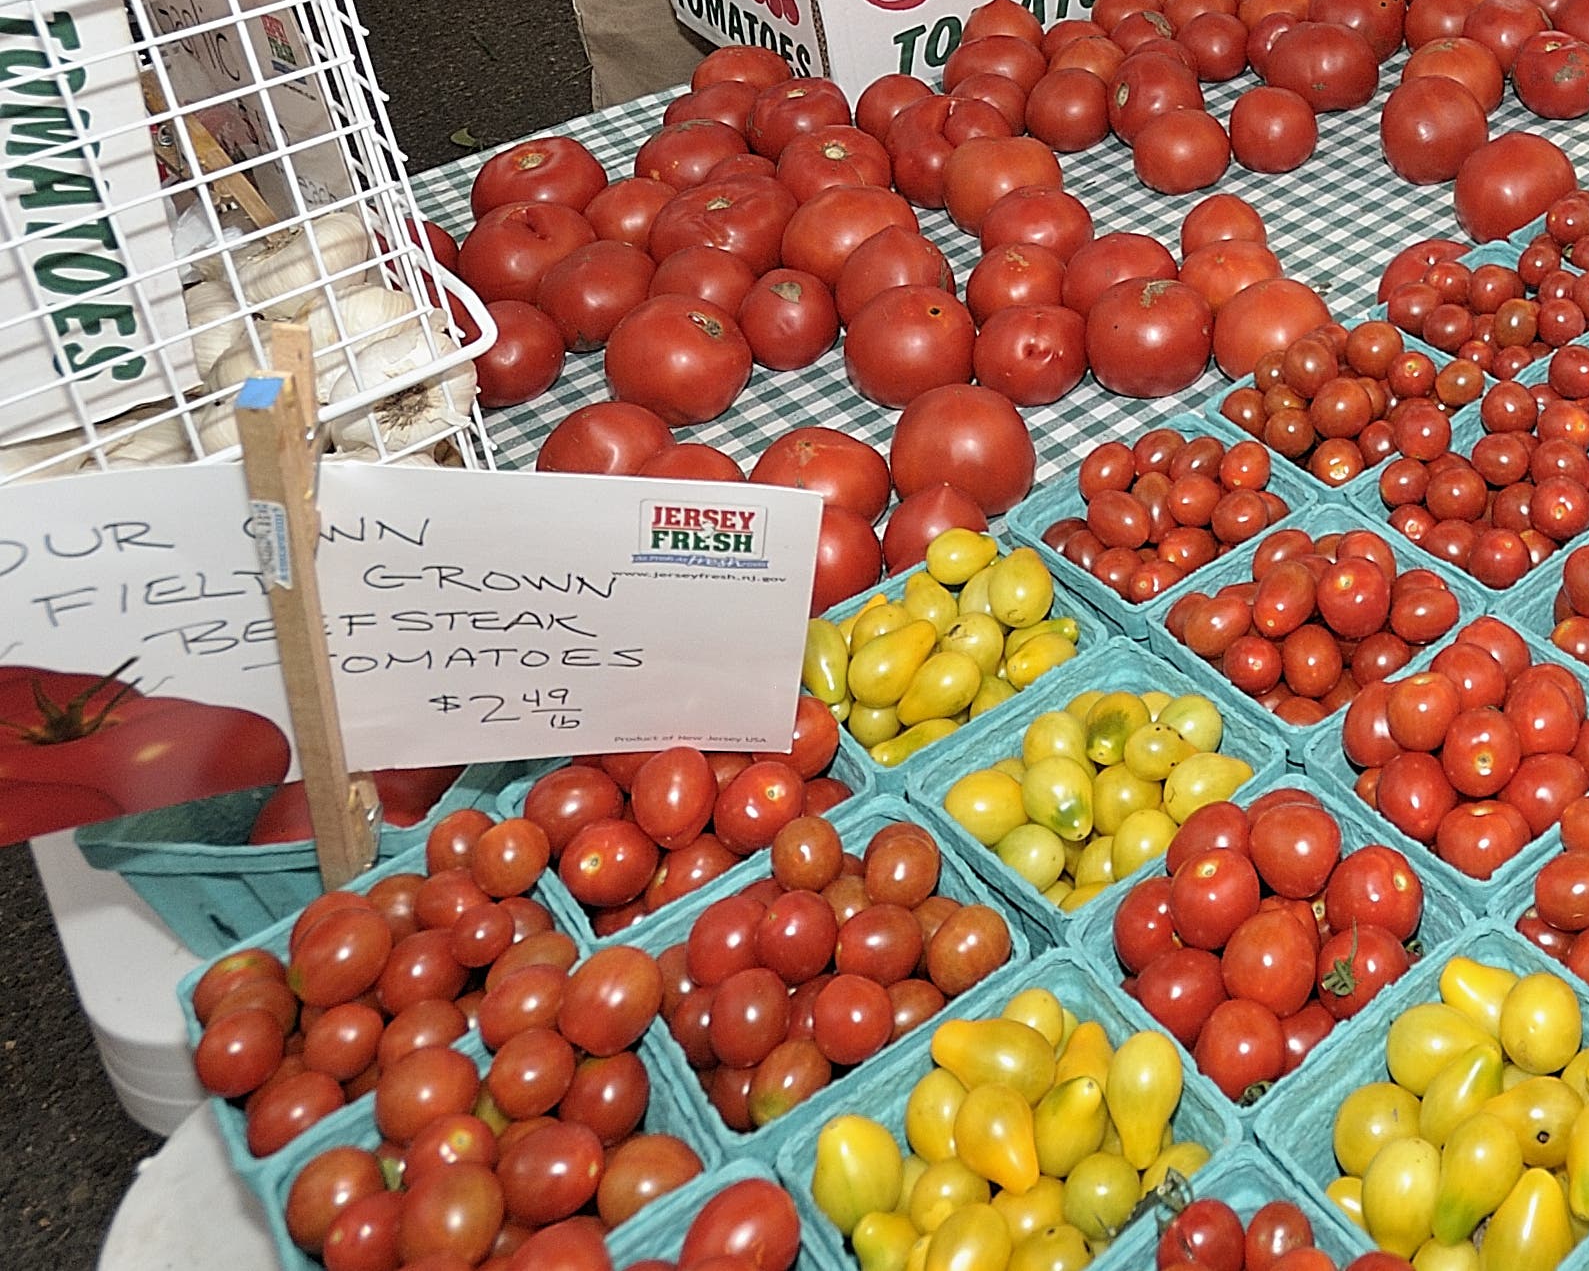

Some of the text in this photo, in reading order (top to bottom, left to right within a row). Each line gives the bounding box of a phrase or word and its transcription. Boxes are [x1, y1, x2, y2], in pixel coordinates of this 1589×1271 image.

[0, 10, 147, 383] TOMATOES
[652, 506, 756, 530] JERSEY
[651, 530, 754, 553] FRESH
[363, 565, 617, 598] GROWN
[612, 571, 787, 583] www.jerseyfresh.nj.gov
[707, 736, 742, 744] Jersey
